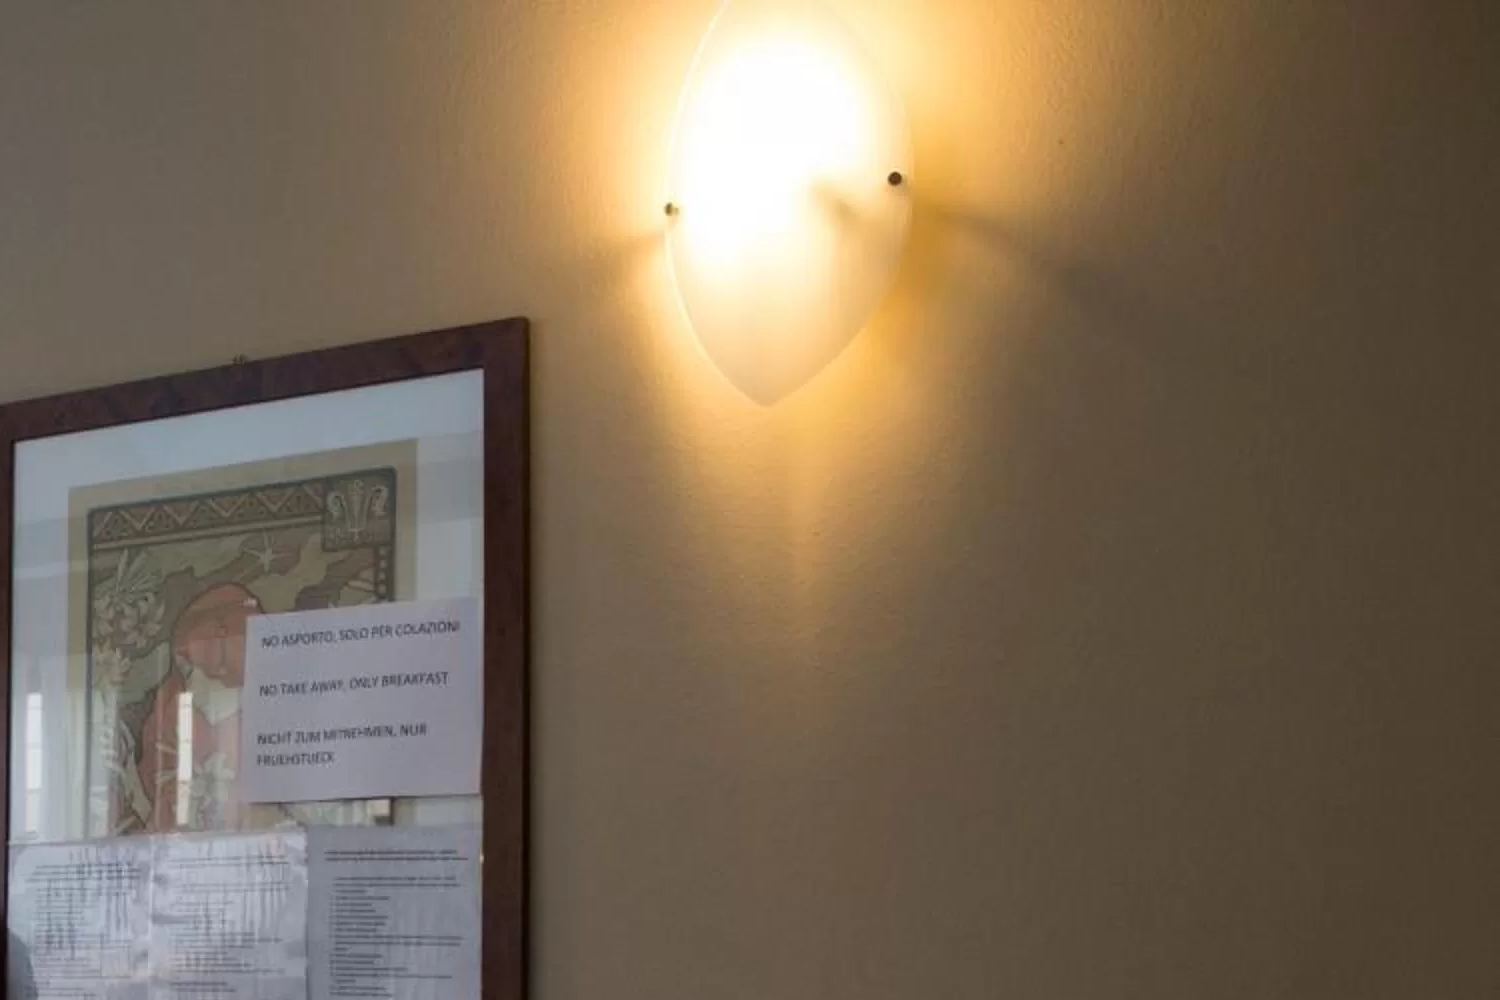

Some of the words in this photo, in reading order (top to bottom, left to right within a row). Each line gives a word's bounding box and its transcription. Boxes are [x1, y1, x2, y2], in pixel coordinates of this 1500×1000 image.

[262, 635, 279, 648] NO
[340, 627, 369, 641] SOLO
[372, 625, 394, 638] PER
[260, 684, 277, 697] NO
[280, 682, 306, 695] TAKE
[349, 675, 378, 689] ONLY
[381, 671, 449, 687] BREAKFAST
[257, 731, 292, 745] NICHT
[295, 729, 321, 743] ZUM
[400, 723, 427, 737] NUR
[257, 751, 335, 766] FRUEHSTUECK
